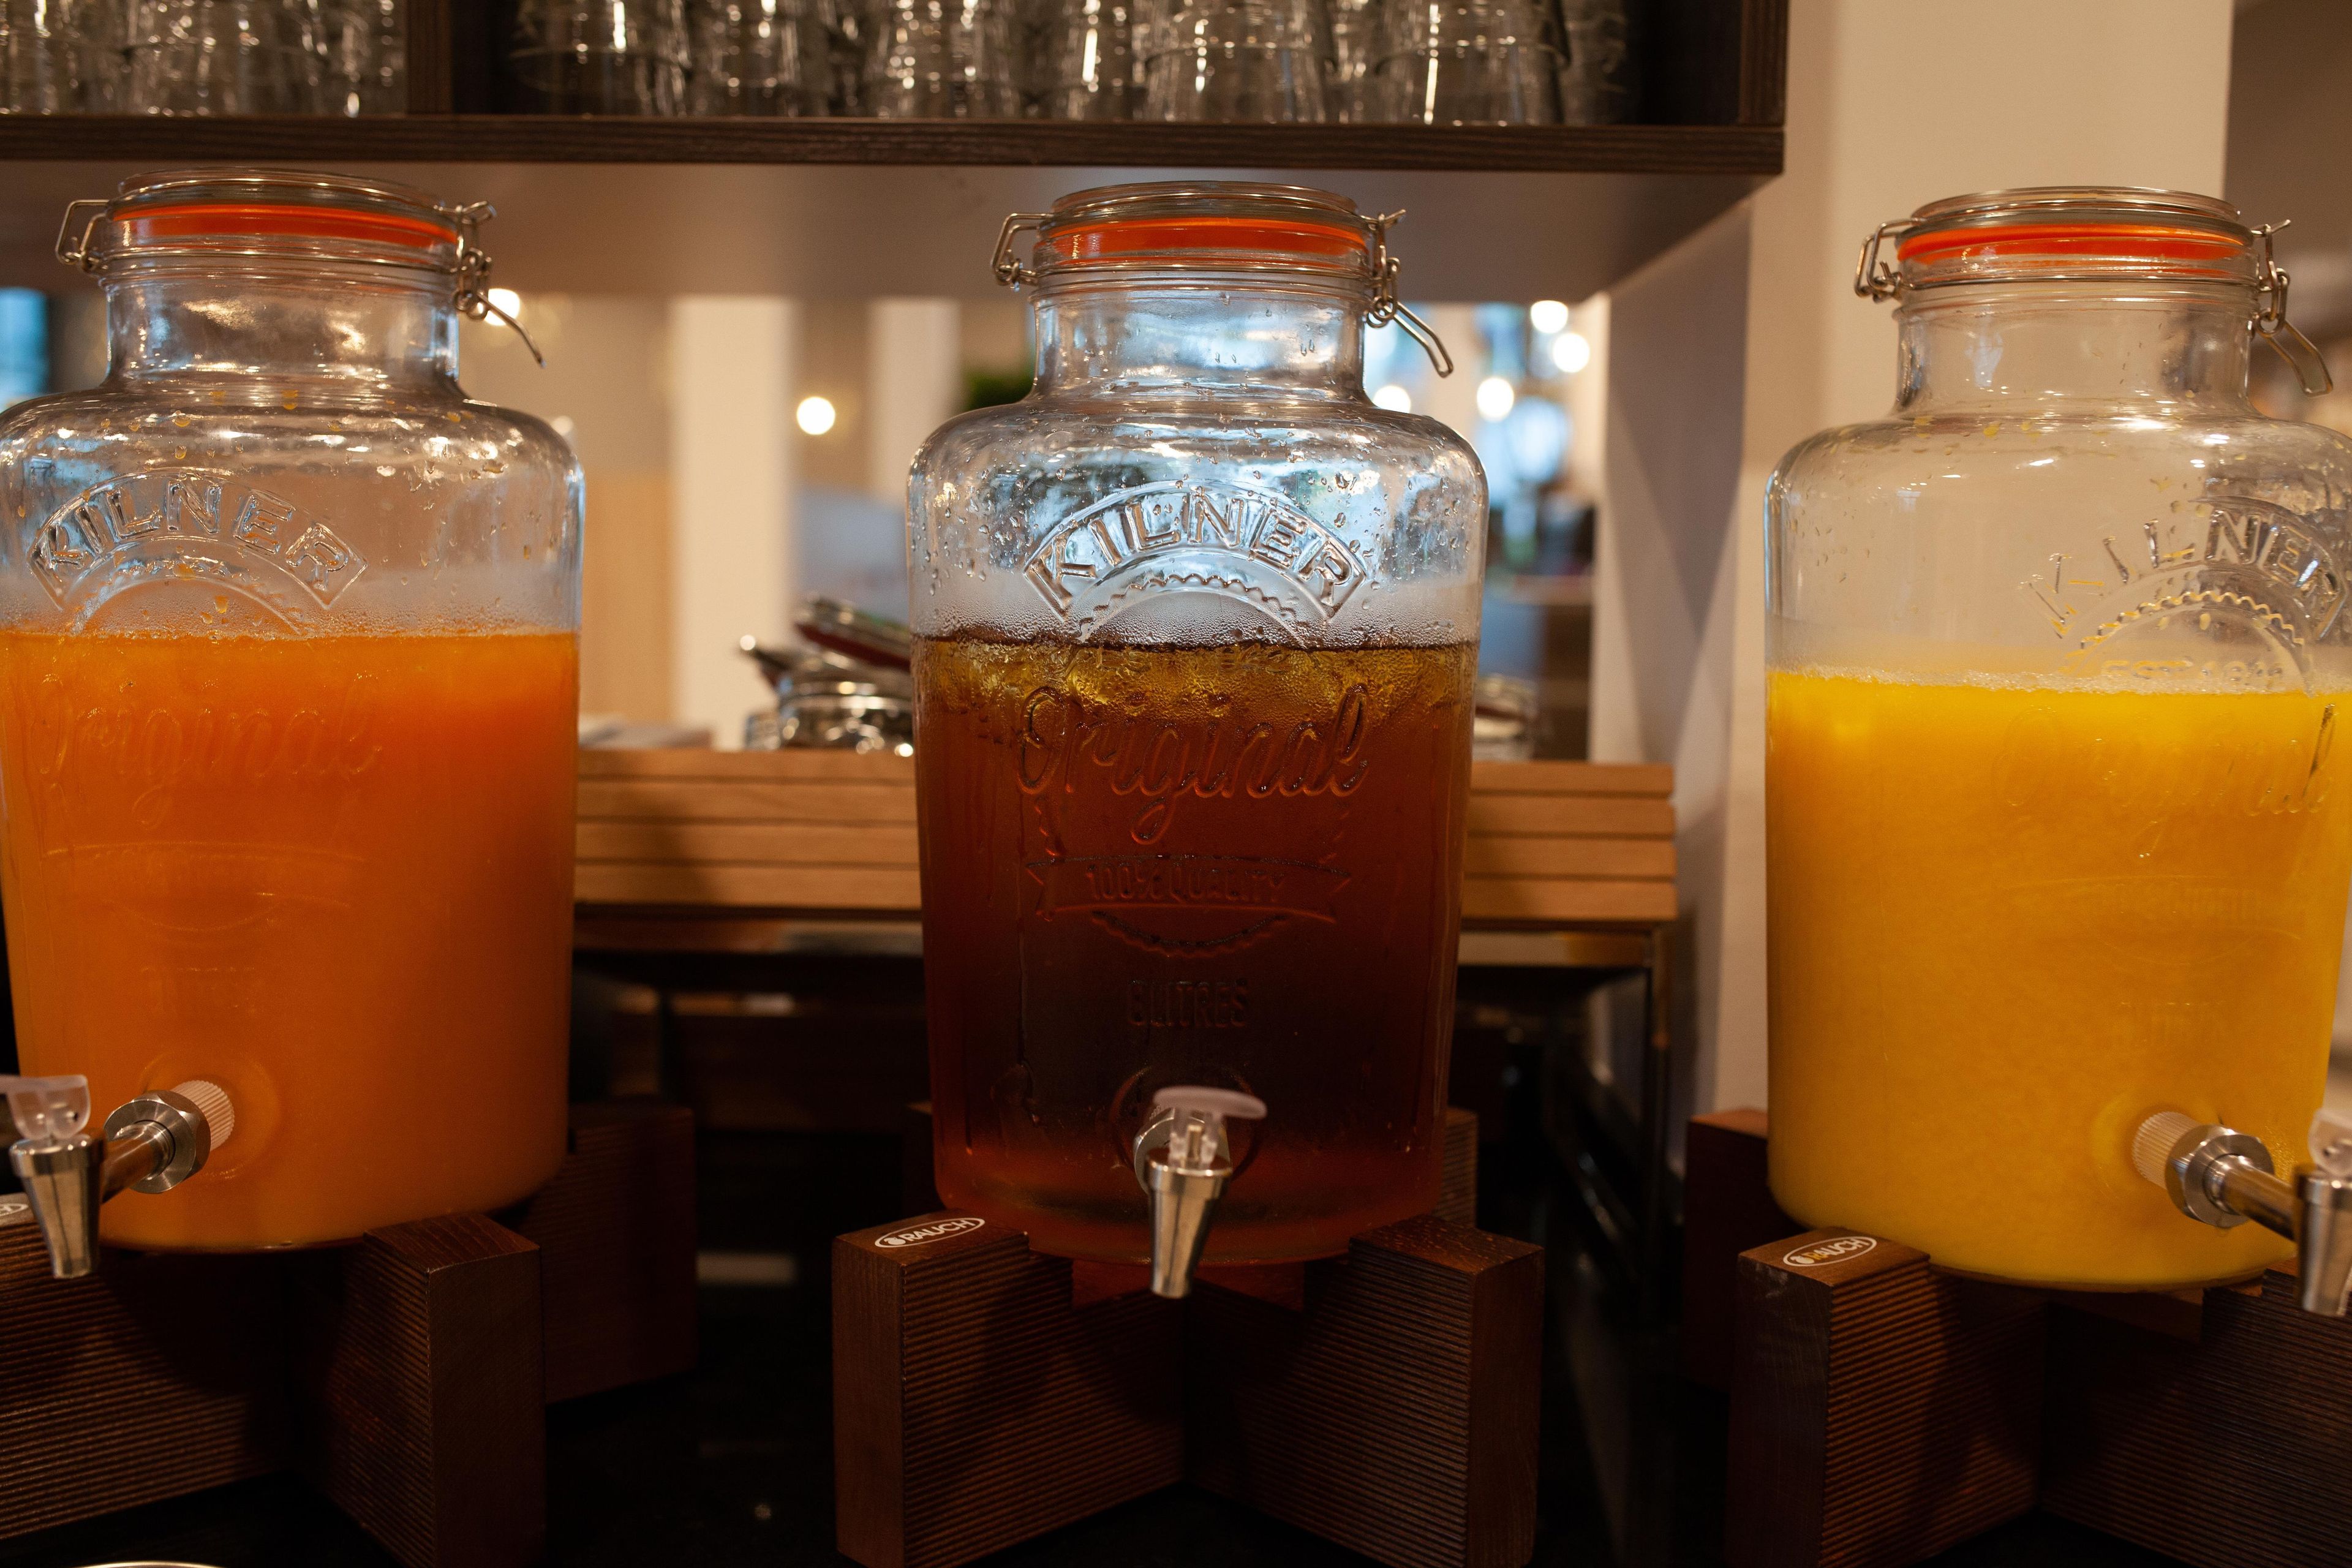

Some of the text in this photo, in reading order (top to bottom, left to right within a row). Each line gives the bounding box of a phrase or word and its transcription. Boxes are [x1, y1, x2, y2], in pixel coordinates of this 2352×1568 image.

[32, 479, 349, 597] KILNER
[1025, 491, 1358, 610] KILNER
[1017, 682, 1369, 845] Original
[902, 1219, 976, 1243] RAUCH
[1804, 1238, 1870, 1261] RAUCH
